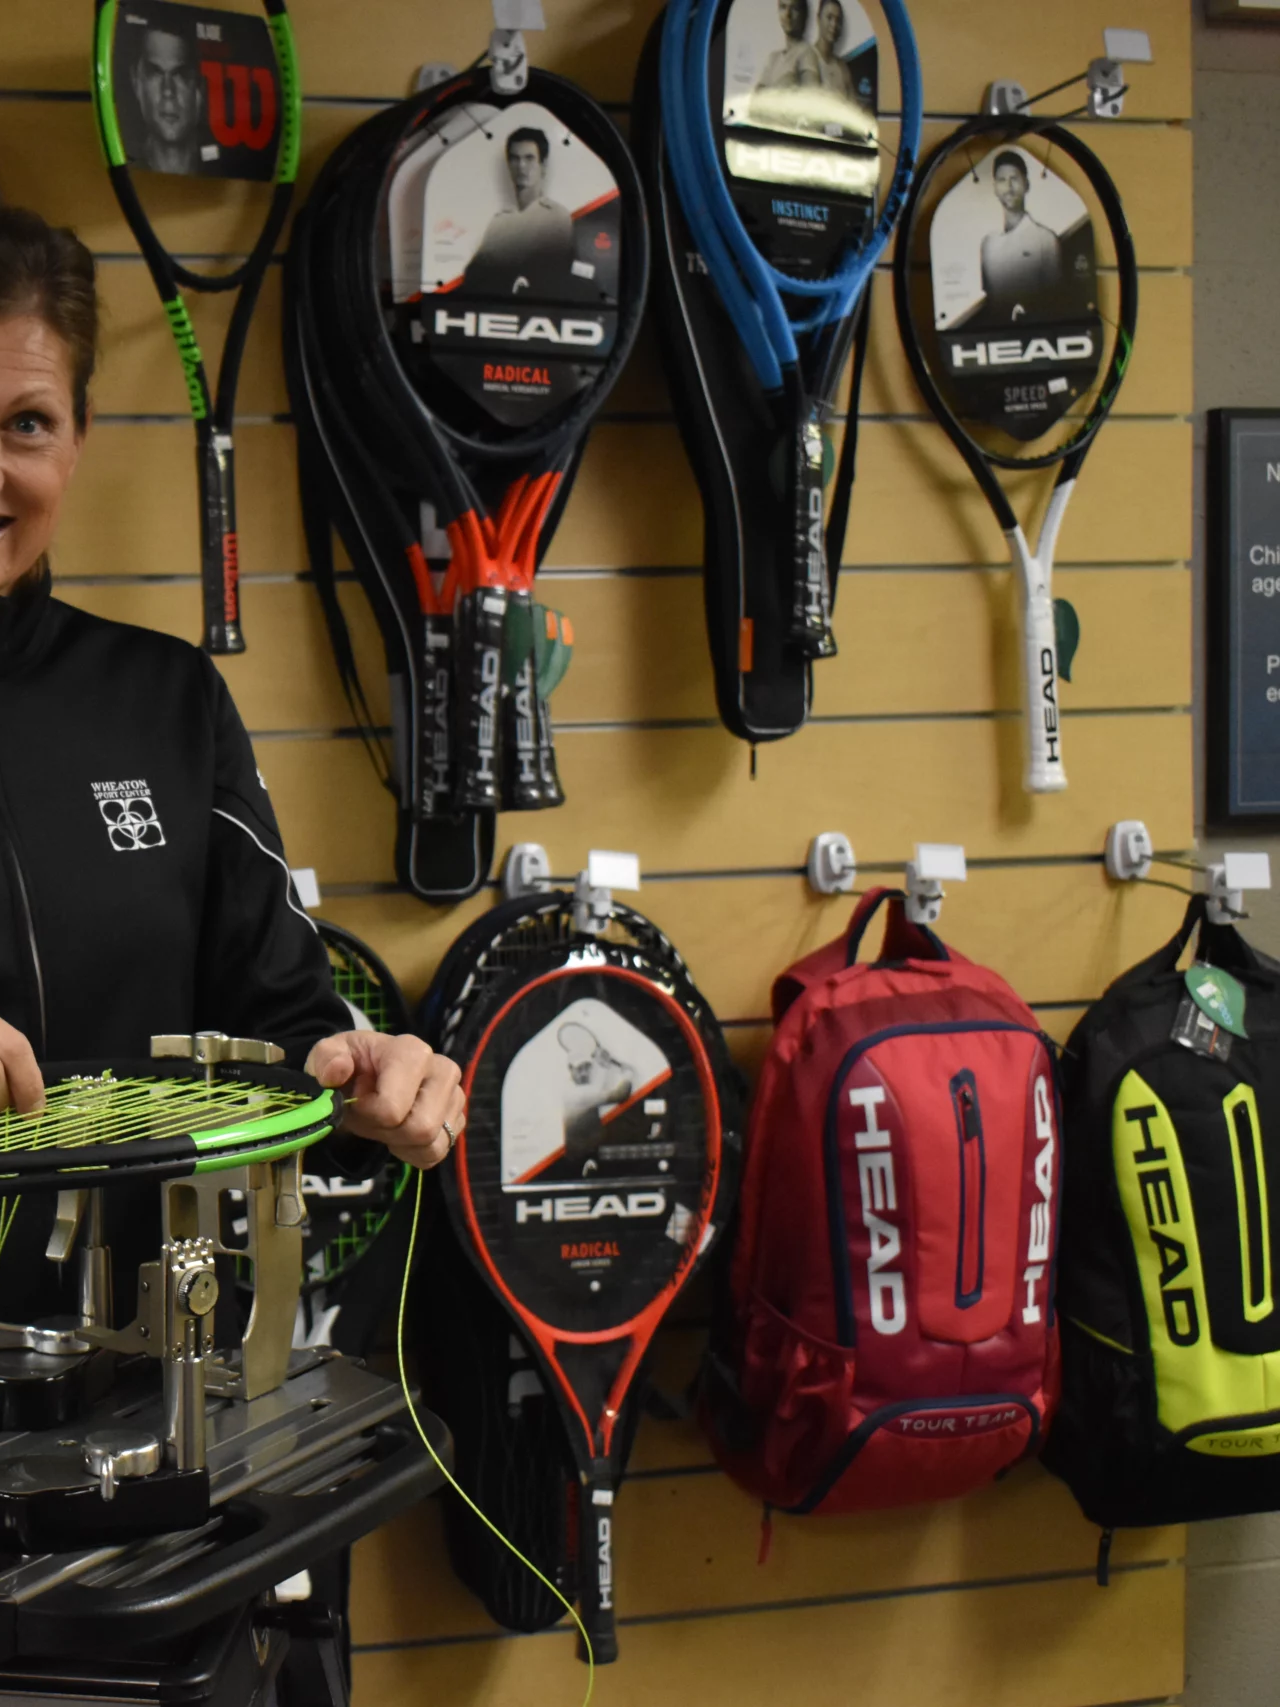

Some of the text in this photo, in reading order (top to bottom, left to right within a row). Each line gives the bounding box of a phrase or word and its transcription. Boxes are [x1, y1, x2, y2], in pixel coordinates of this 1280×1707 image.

[199, 60, 277, 151] W
[771, 198, 829, 222] INSTINCT
[434, 308, 605, 347] HEAD
[951, 335, 1093, 367] HEAD
[483, 363, 552, 385] RADICAL
[1004, 385, 1046, 402] SPEED
[806, 487, 824, 616] HEAD
[477, 650, 500, 781] HEAD
[1041, 648, 1059, 763] HEAD
[433, 668, 449, 793] HEAD
[90, 779, 148, 792] WHEATON
[93, 788, 152, 800] SPORT CENTER
[516, 1192, 667, 1224] HEAD
[849, 1085, 908, 1335] HEAD
[1022, 1074, 1055, 1325] HEAD
[1124, 1103, 1200, 1347] HEAD
[560, 1241, 620, 1260] RADICAL
[900, 1409, 1018, 1432] TOUR TEAM
[1207, 1434, 1265, 1452] TOUR
[598, 1517, 613, 1610] HEAD
